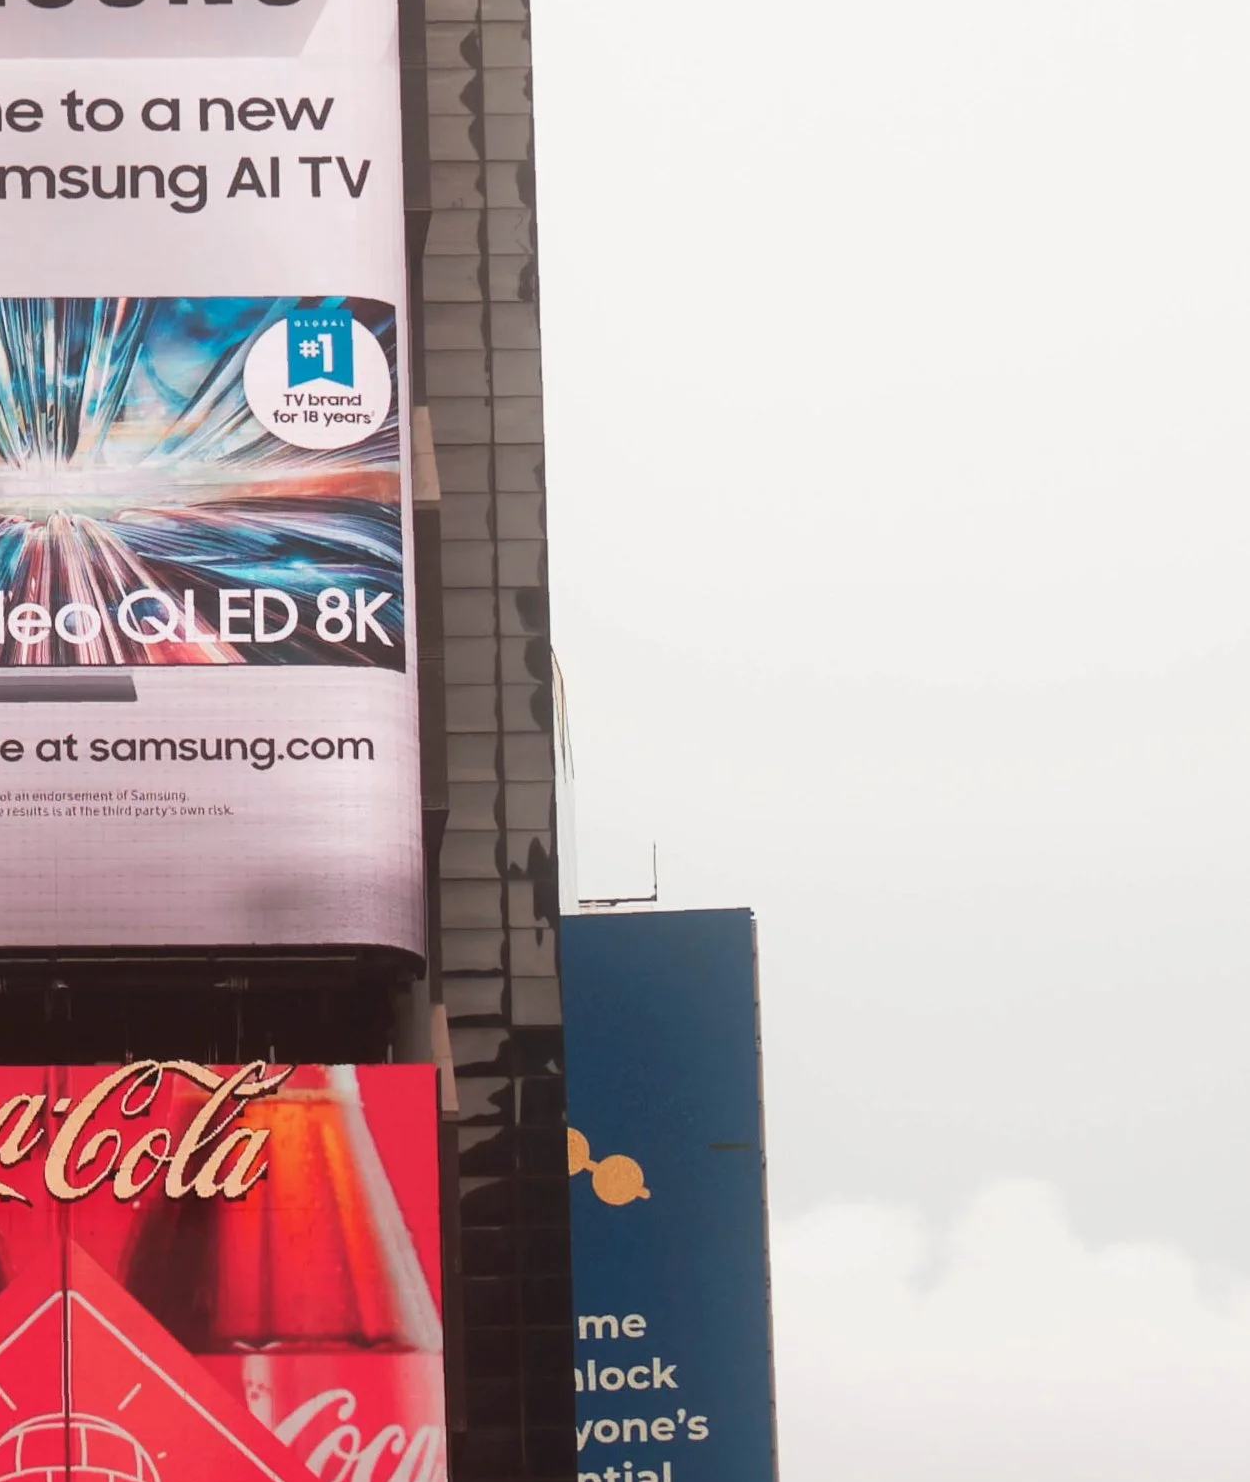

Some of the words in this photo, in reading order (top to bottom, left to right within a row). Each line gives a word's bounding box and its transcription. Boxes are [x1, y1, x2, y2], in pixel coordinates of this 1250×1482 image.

[60, 89, 124, 133] to
[140, 97, 181, 132] a
[199, 97, 335, 132] new
[226, 156, 280, 199] AI
[298, 155, 371, 199] TV
[298, 333, 334, 373] #1
[273, 410, 299, 424] for
[303, 410, 319, 424] 18
[283, 394, 305, 406] TV
[308, 393, 362, 406] brand
[117, 588, 298, 647] QLED
[315, 586, 395, 647] 8K
[35, 733, 79, 763] at
[89, 737, 375, 771] samsung.com
[6, 805, 49, 818] results
[65, 805, 78, 818] at
[80, 805, 101, 818] the
[102, 805, 131, 818] third
[180, 805, 206, 818] own
[32, 789, 113, 803] endorsement
[116, 789, 129, 803] of
